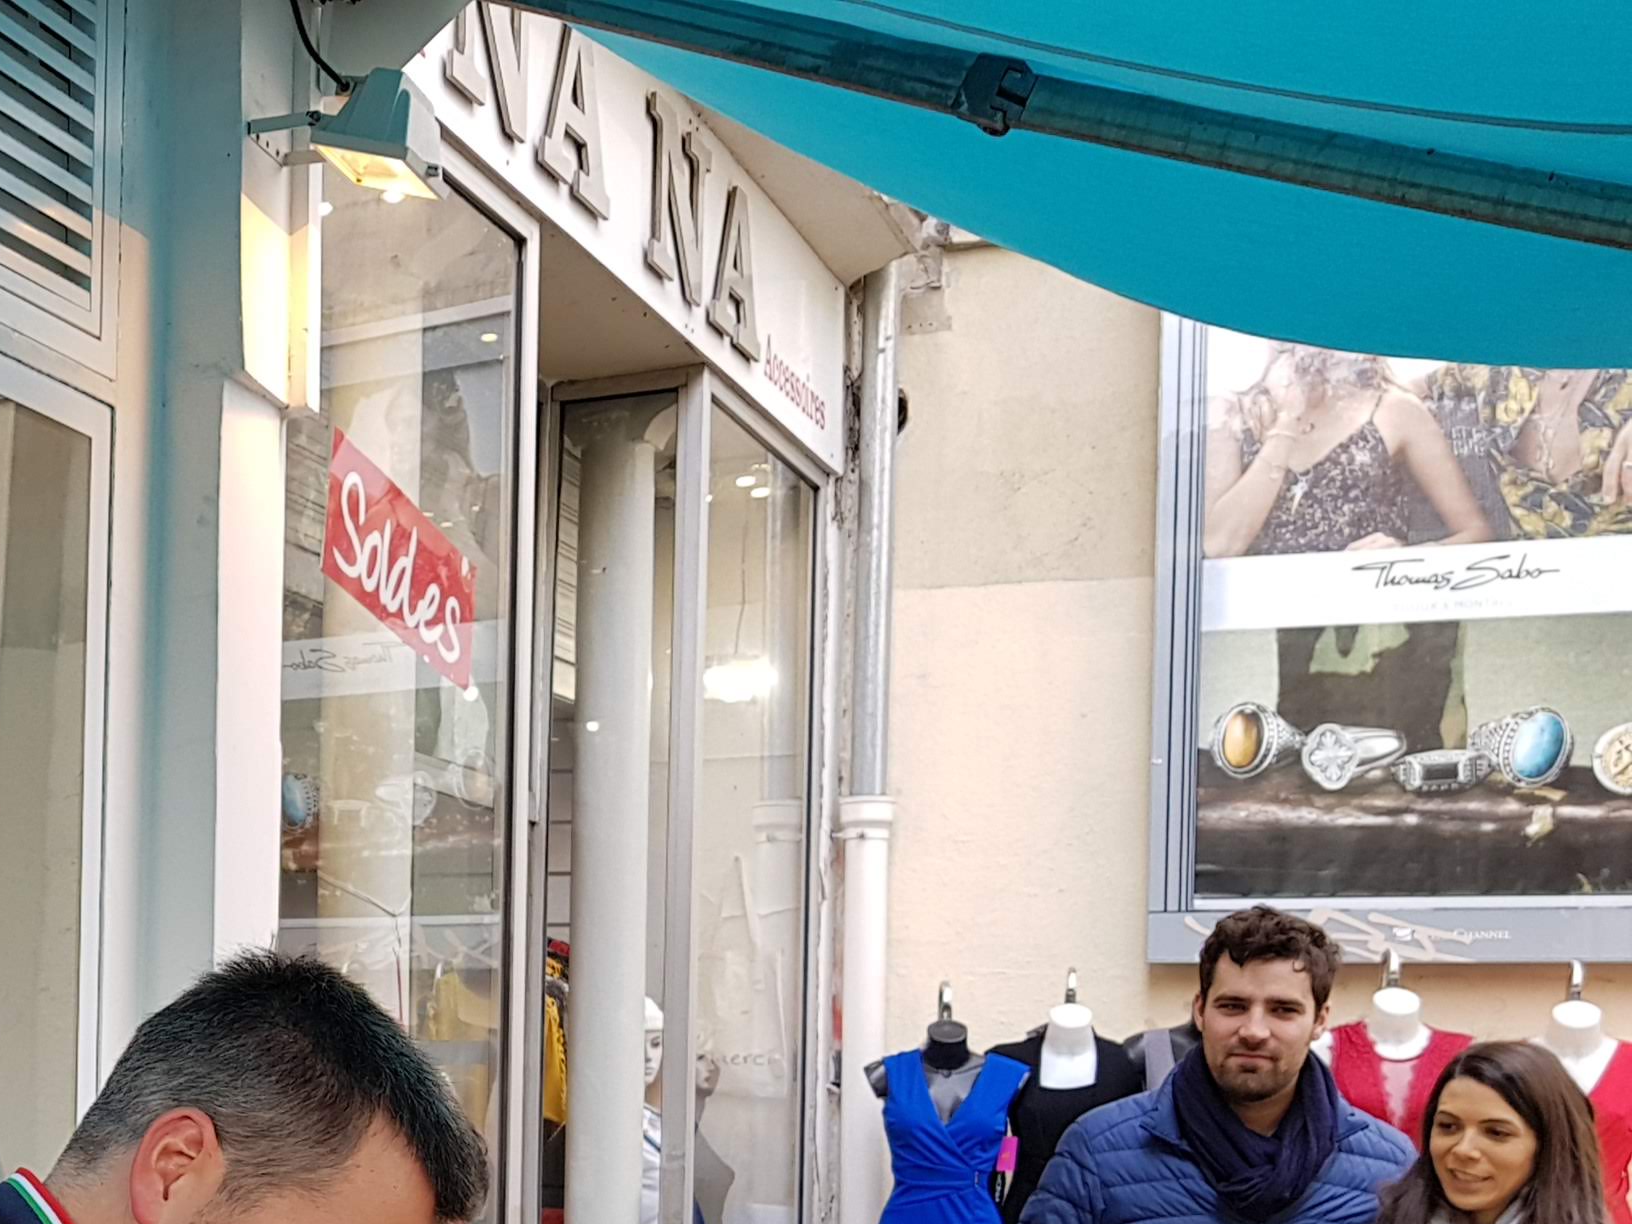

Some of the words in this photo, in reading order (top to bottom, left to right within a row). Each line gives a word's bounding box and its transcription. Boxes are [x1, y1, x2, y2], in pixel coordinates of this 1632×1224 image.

[644, 90, 761, 362] NA
[764, 333, 826, 430] Accessoires
[332, 471, 460, 663] Soldes
[1352, 558, 1455, 590] Thomas
[1449, 553, 1560, 591] Sabo
